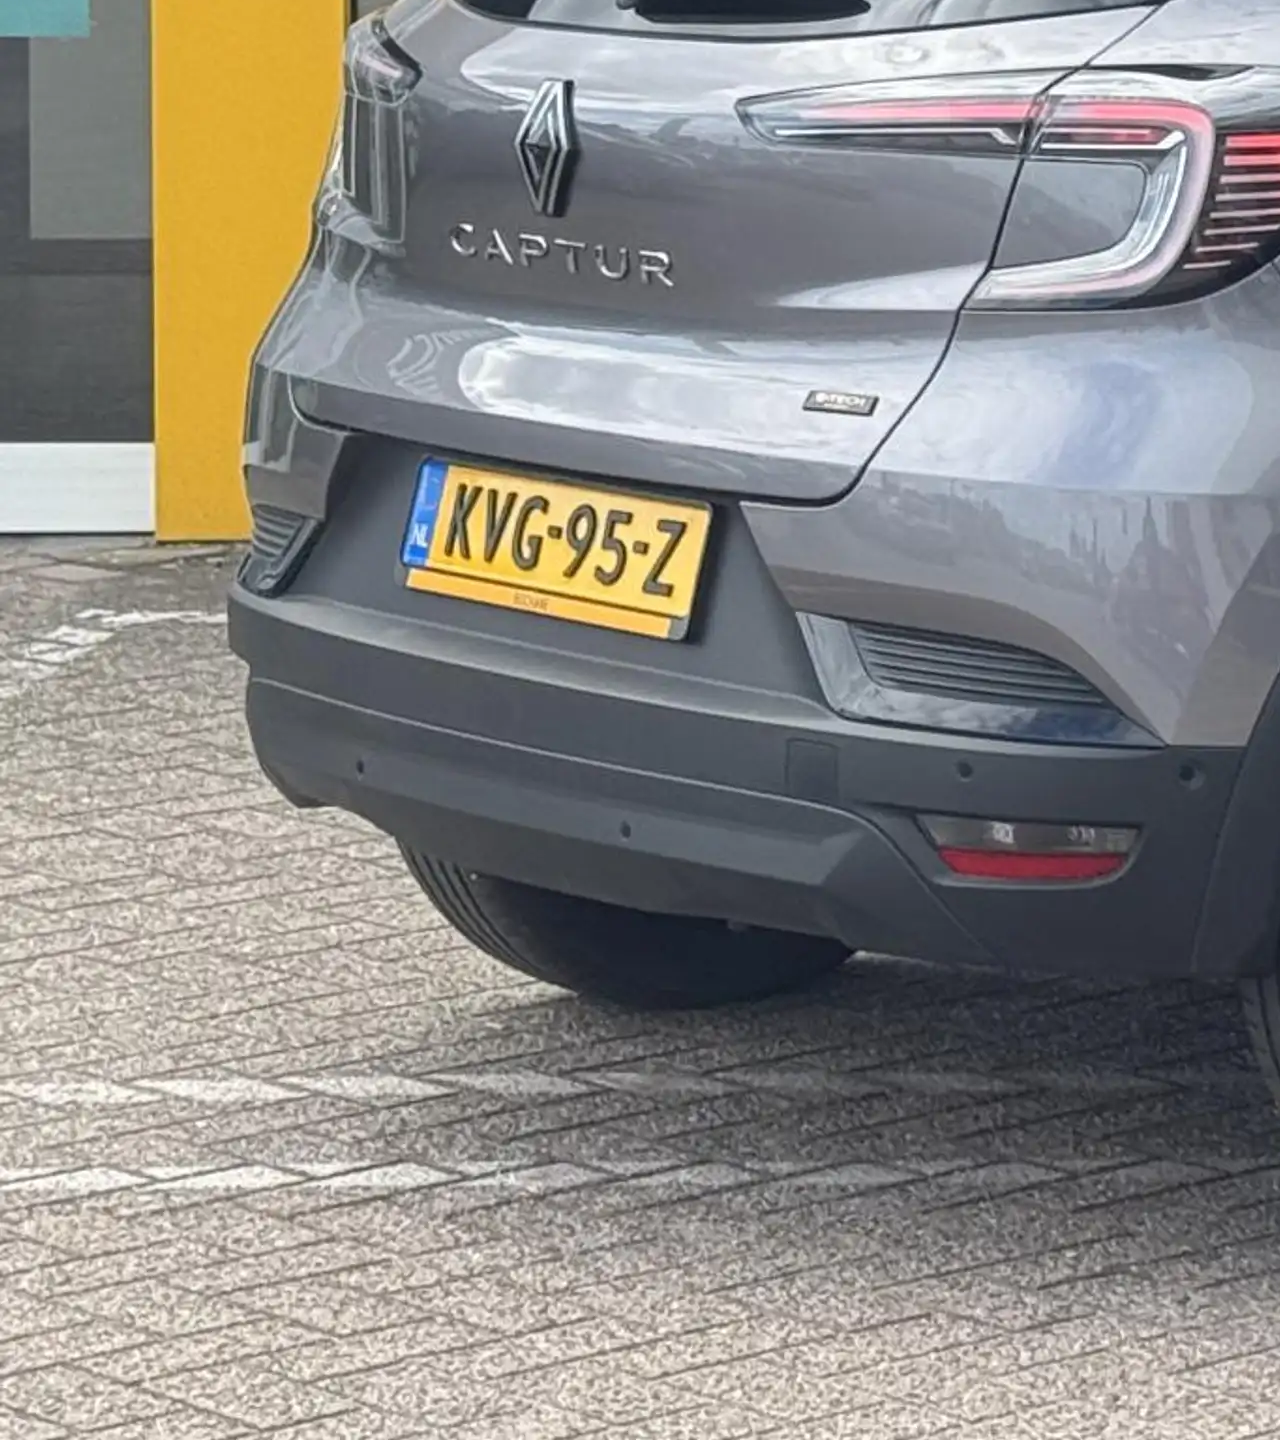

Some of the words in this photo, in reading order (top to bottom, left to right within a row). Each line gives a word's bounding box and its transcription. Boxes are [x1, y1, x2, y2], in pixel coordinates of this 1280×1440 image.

[451, 223, 675, 287] CAPTUR
[412, 525, 428, 548] NL
[444, 483, 687, 598] KVG-95-Z
